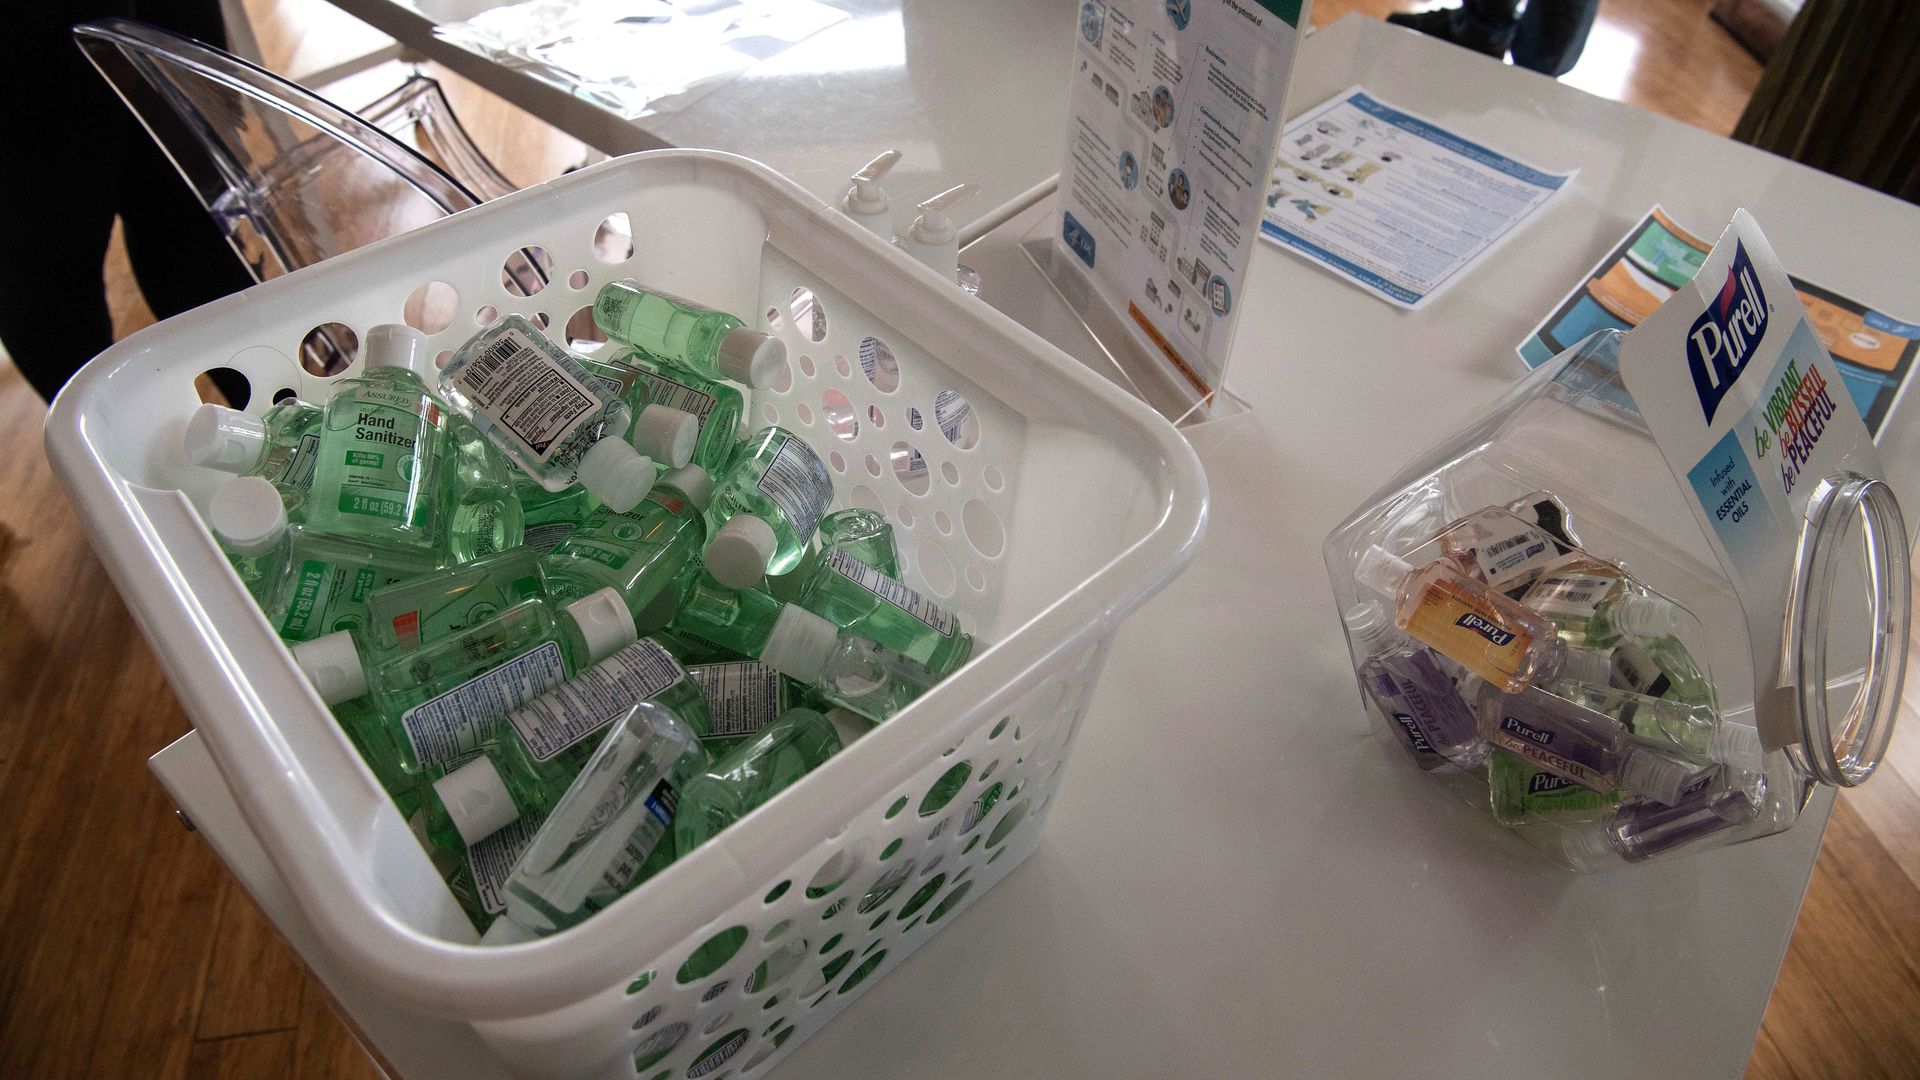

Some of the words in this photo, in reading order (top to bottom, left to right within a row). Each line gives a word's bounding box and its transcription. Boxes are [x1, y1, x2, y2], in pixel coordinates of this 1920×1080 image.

[1691, 266, 1765, 391] Purell
[536, 374, 559, 395] Warnings
[362, 390, 411, 405] ASSURED
[573, 398, 588, 412] Drug
[1784, 363, 1827, 437] BLISSFUL
[562, 407, 578, 421] Facts
[1754, 426, 1771, 460] be
[1763, 358, 1803, 436] VIBRANT
[357, 414, 396, 430] Hand
[355, 426, 417, 449] Sanitizer
[1778, 428, 1791, 460] be
[1780, 462, 1795, 496] be
[1788, 388, 1837, 474] PEACEFUL
[1710, 457, 1736, 488] Infused
[1720, 479, 1736, 497] with
[353, 498, 360, 509] 2
[361, 498, 369, 510] fl
[370, 502, 379, 512] oz
[1716, 479, 1753, 521] ESSENTIAL
[1732, 502, 1749, 524] OILS
[302, 587, 314, 597] oz
[304, 579, 319, 587] fl
[294, 597, 312, 618] (59.2
[288, 617, 304, 631] mL)
[1462, 614, 1508, 645] Purell
[1402, 679, 1441, 732] PEACEFUL
[1400, 717, 1430, 749] Purell
[1507, 719, 1550, 744] Purell
[534, 745, 547, 757] Drug
[1504, 739, 1520, 750] be
[1524, 744, 1586, 779] PEACEFUL
[1534, 774, 1572, 791] Pure
